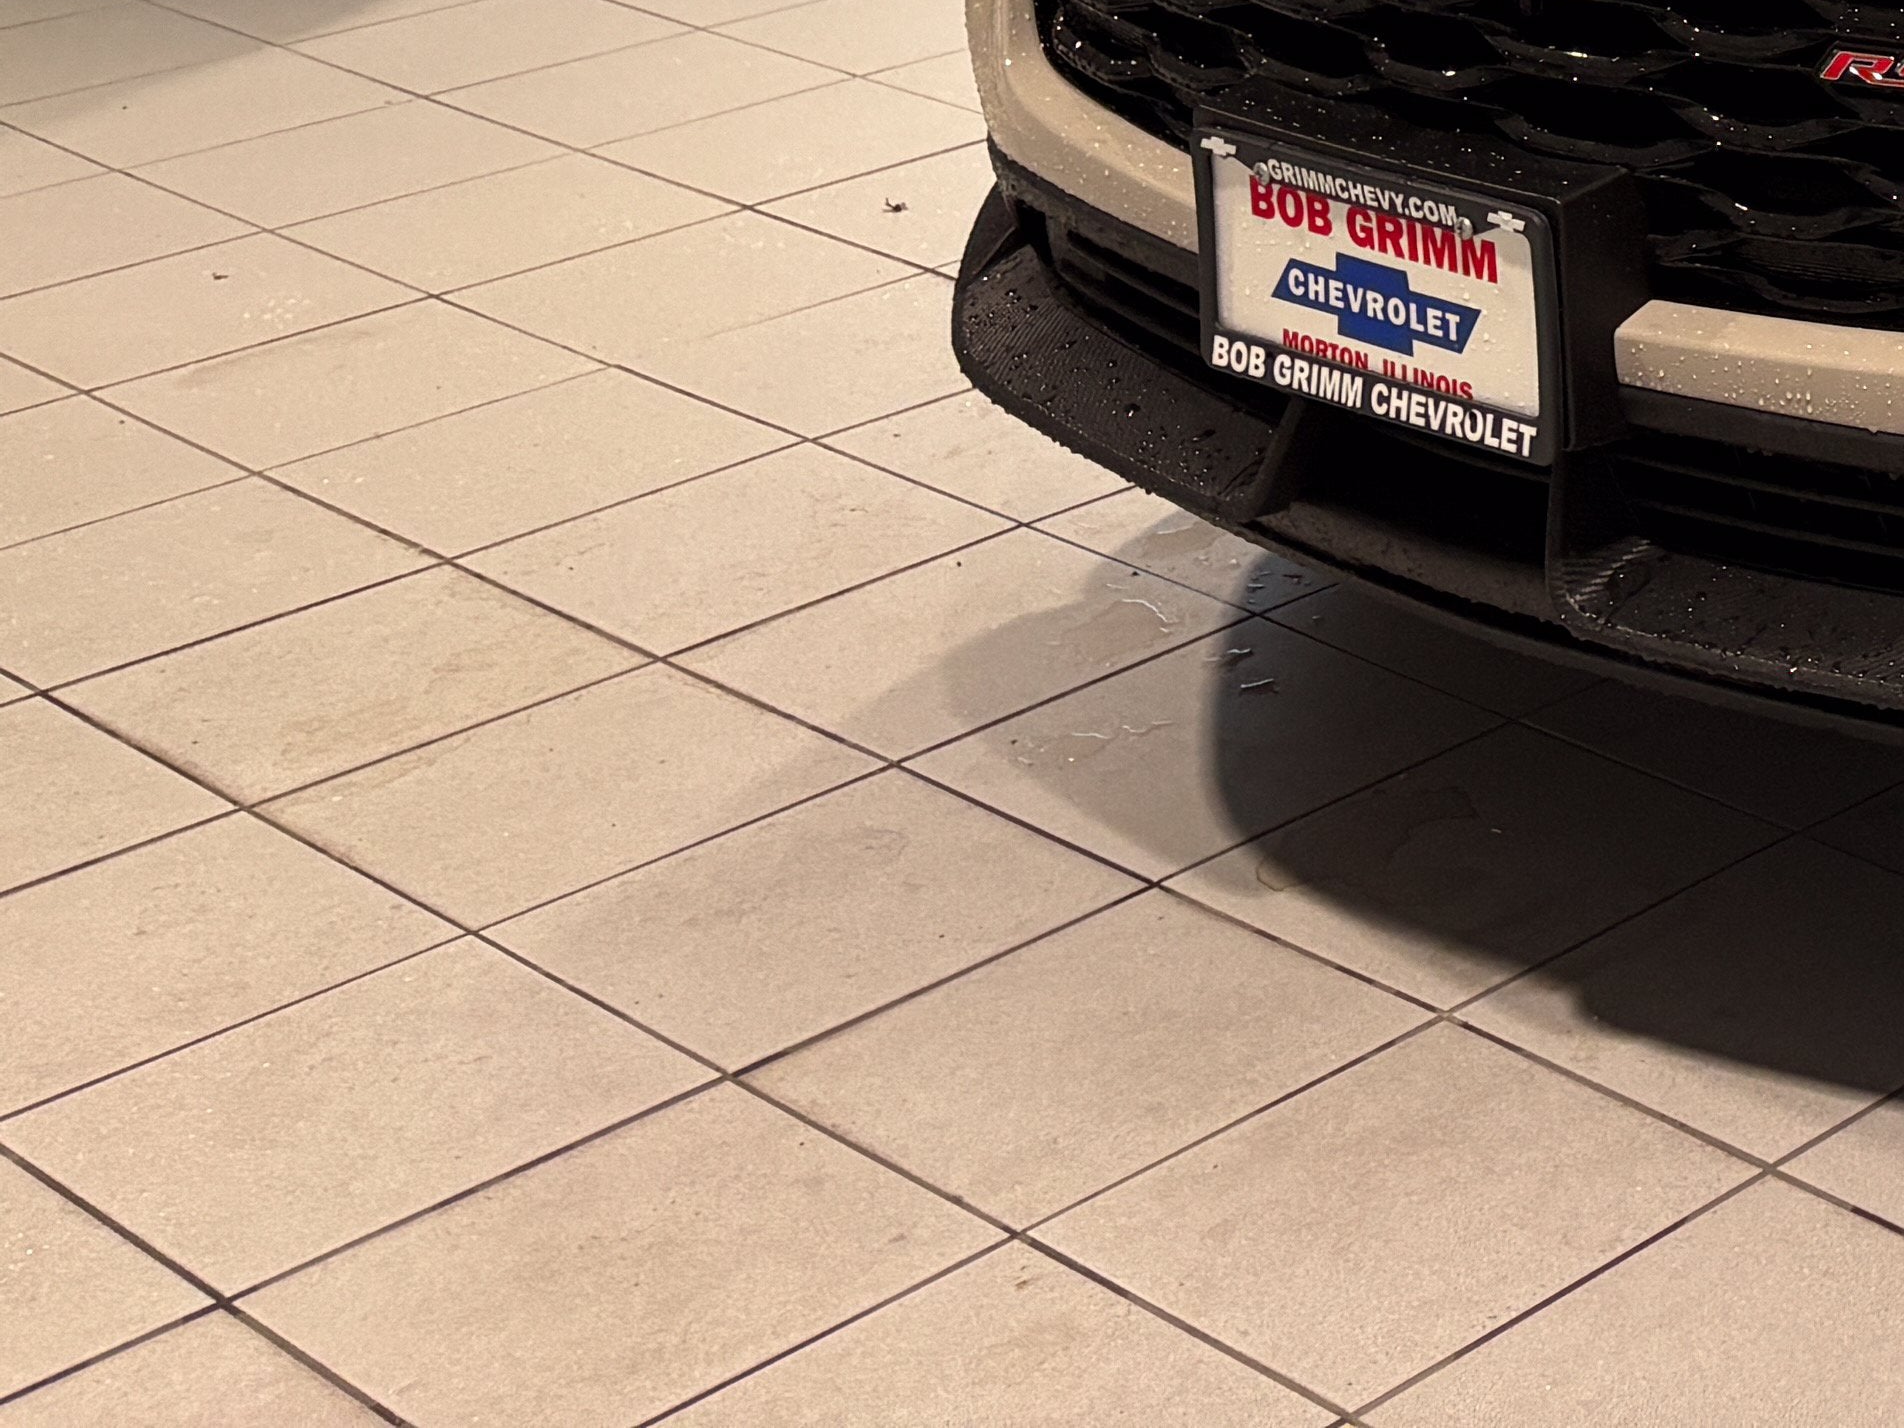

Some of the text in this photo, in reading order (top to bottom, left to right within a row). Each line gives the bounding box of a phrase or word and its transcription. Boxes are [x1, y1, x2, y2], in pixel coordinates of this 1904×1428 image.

[1249, 174, 1498, 284] BOB GRIMM
[1267, 158, 1458, 227] GRIMMCHEVY.COM
[1288, 268, 1461, 342] CHEVROLET
[1211, 334, 1538, 458] BOB GRIMM CHEVROLET
